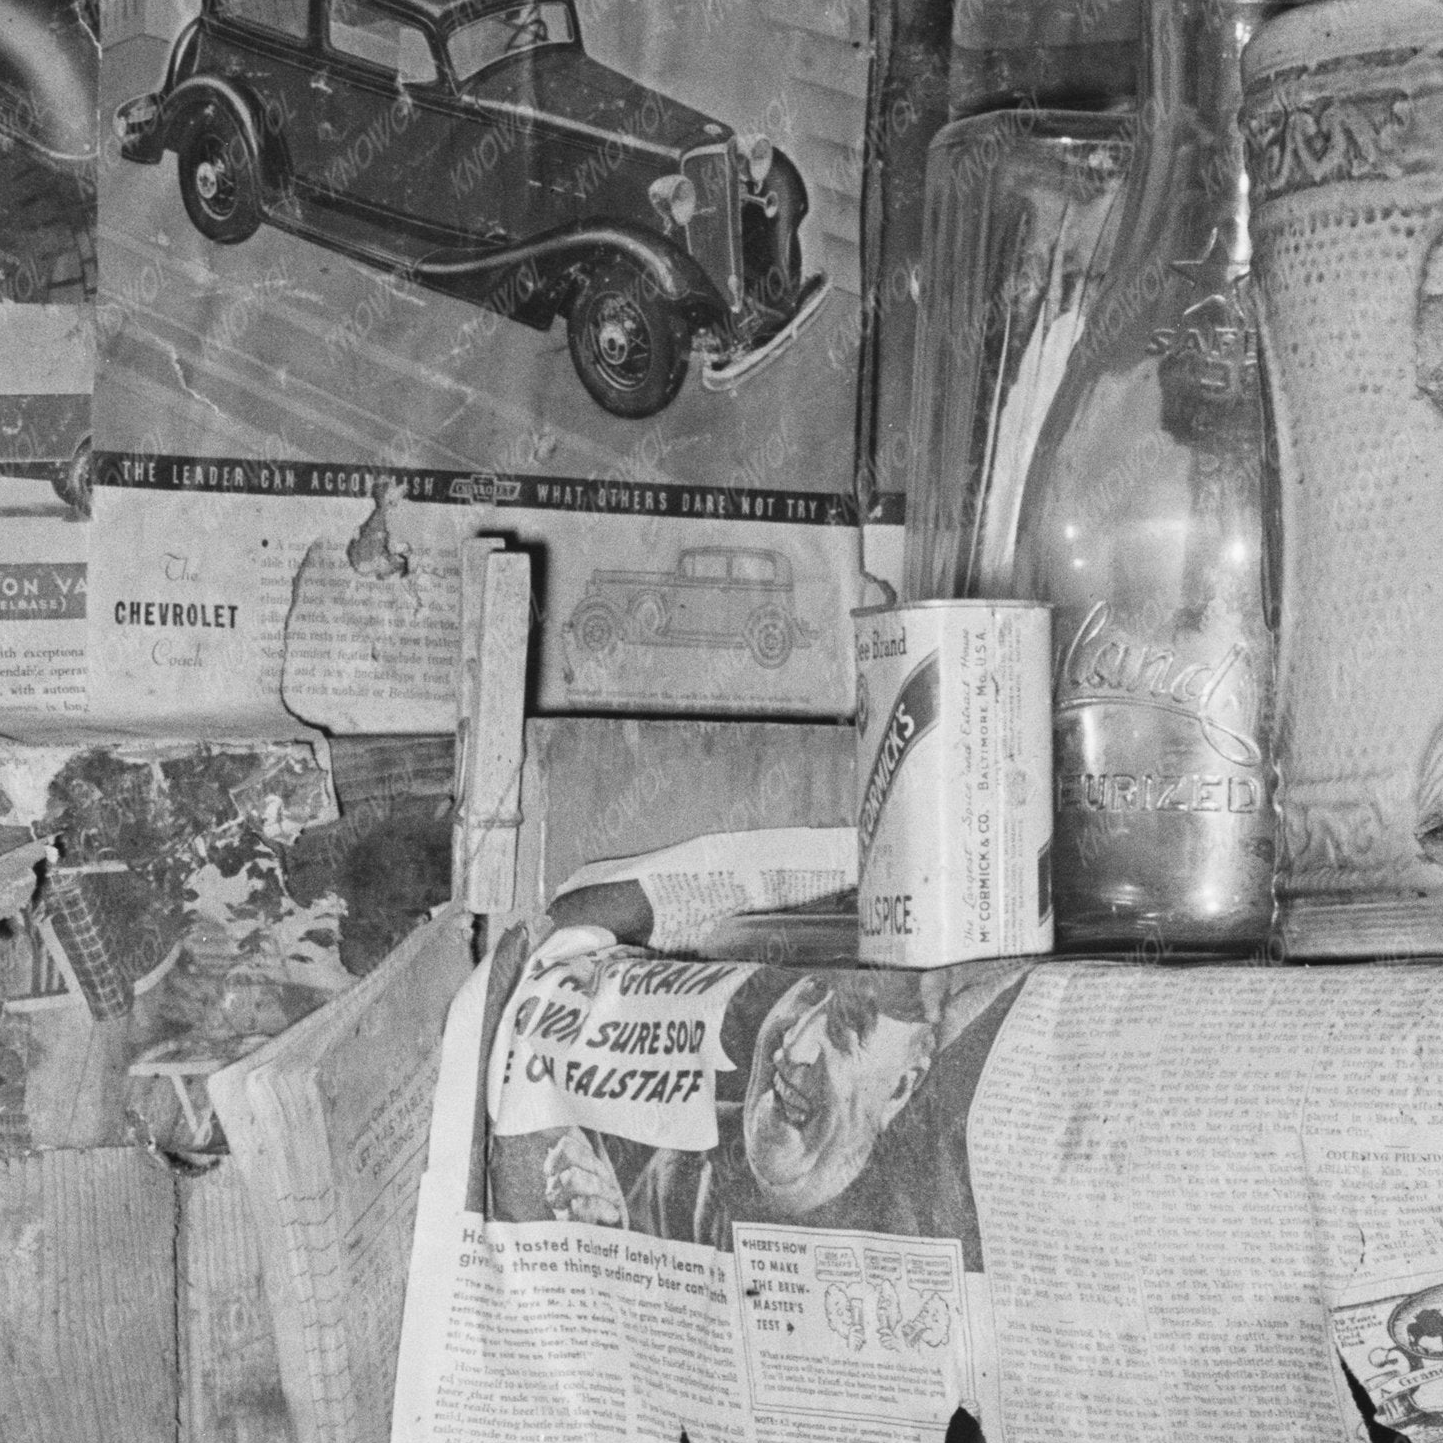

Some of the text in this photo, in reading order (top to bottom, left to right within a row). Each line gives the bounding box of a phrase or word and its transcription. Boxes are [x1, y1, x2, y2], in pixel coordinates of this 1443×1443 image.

[123, 461, 294, 489] THE LEADER CAN
[537, 483, 817, 519] WHAT OTHERS DARE NOT TRY
[114, 600, 239, 629] CHEVROLET
[873, 627, 906, 660] Brand
[977, 707, 989, 791] BALTIMORE
[585, 1020, 706, 1055] SURE SOLD
[564, 1060, 704, 1104] FALSTAFF
[515, 1237, 569, 1253] tasted
[576, 1239, 619, 1259] Falstaff
[625, 1246, 668, 1271] lately?
[783, 1242, 807, 1255] HOW
[512, 1259, 558, 1273] three
[605, 1268, 653, 1290] ordinary
[658, 1272, 682, 1293] beer
[751, 1259, 799, 1274] TO MAKE
[753, 1279, 810, 1294] THE BREW-
[753, 1299, 804, 1314] MASTER'S
[756, 1319, 780, 1331] TEST
[1378, 1387, 1392, 1399] A
